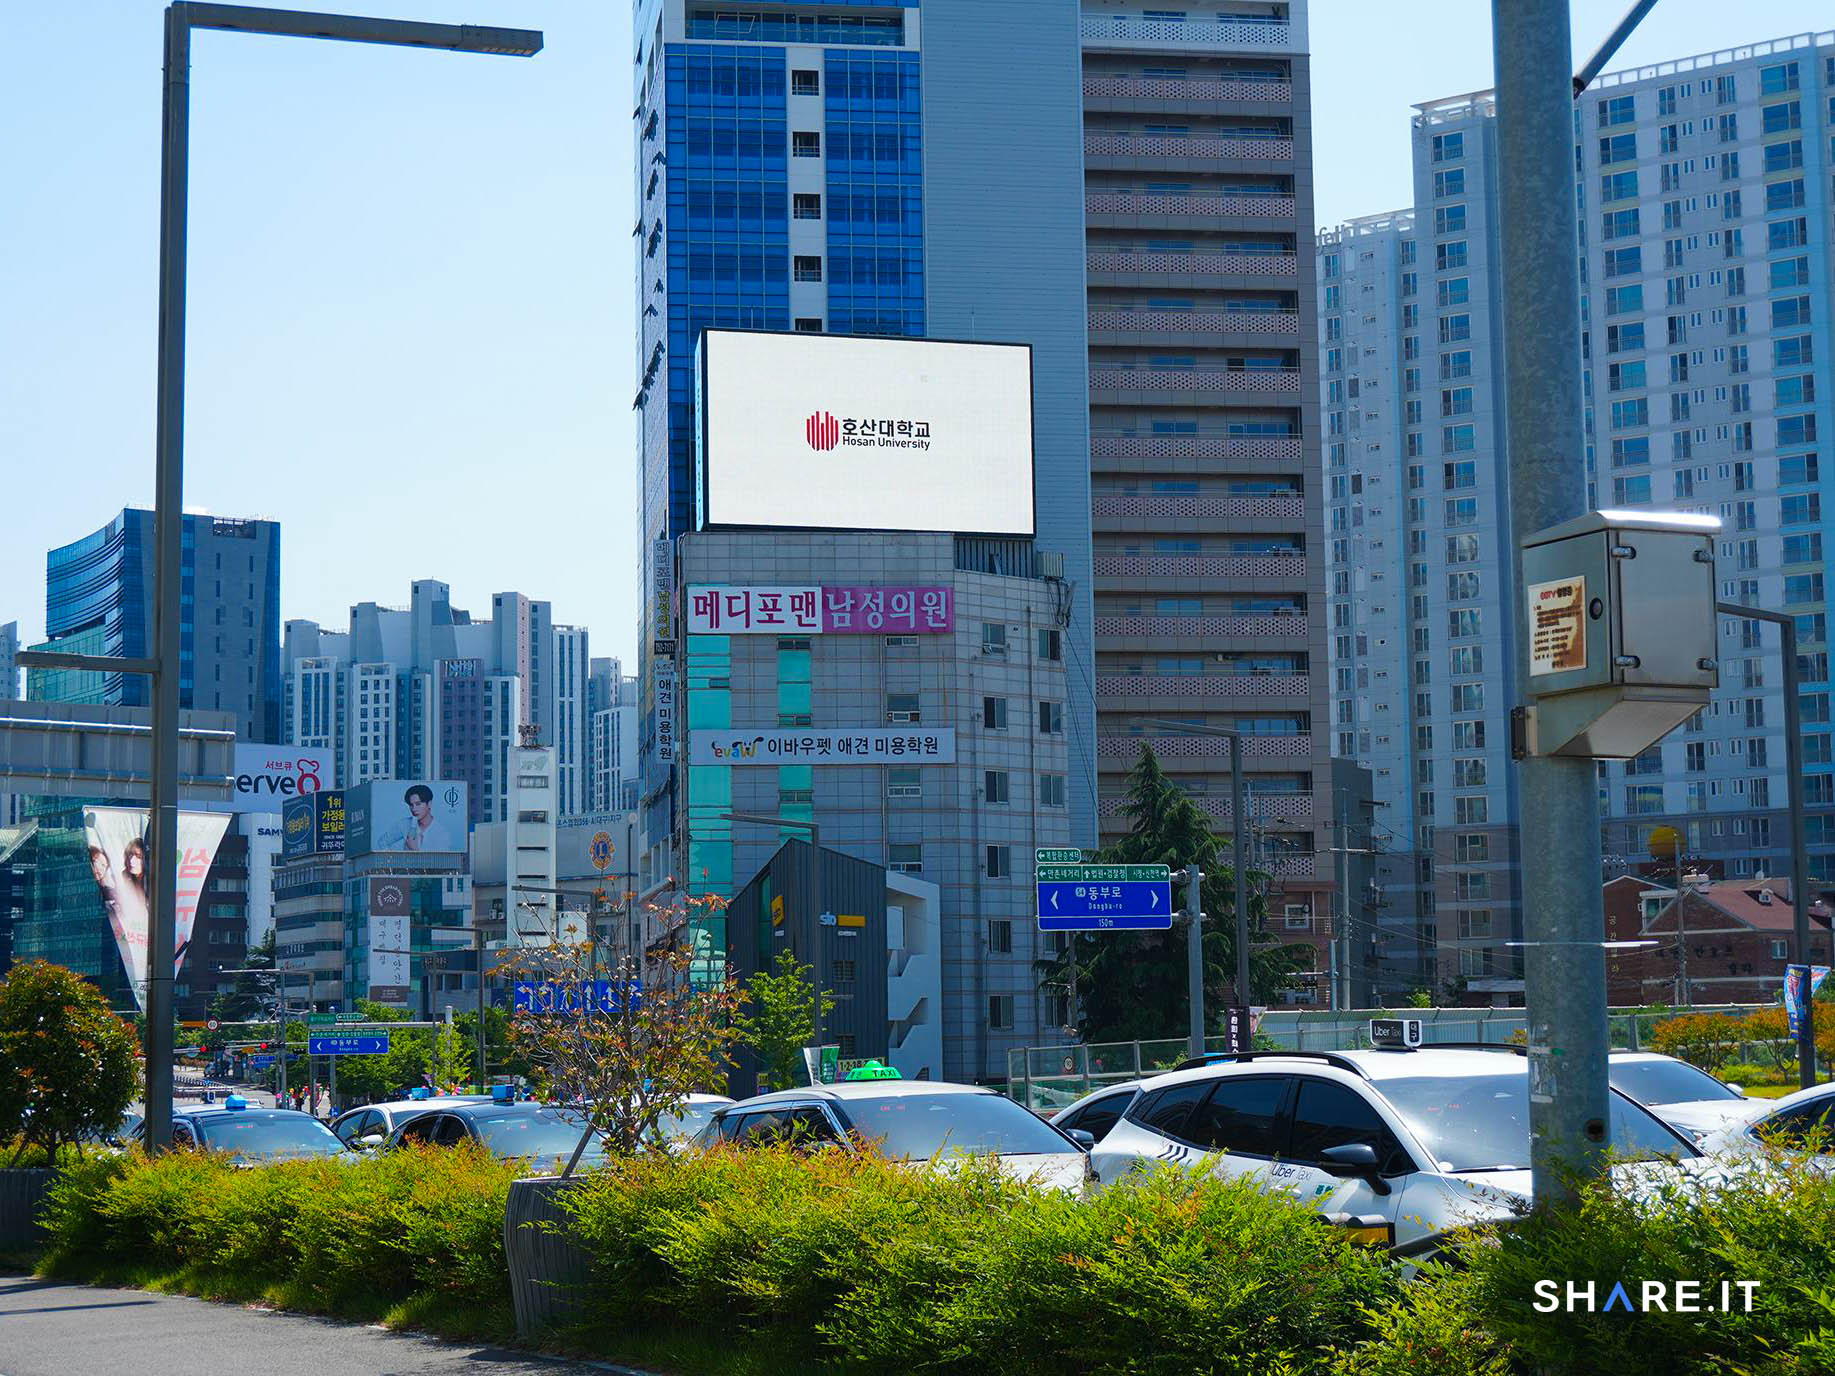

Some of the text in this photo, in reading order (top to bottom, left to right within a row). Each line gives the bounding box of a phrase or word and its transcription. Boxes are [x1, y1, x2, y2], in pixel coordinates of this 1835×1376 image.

[842, 418, 931, 437] 호산대학교
[842, 436, 931, 451] Hosan University
[693, 591, 947, 630] 메디포맨 남성의원
[659, 679, 671, 704] 애견
[659, 708, 672, 760] 미용학원
[767, 736, 939, 756] 이바우펫 애견 미용학원
[265, 760, 294, 772] 서브큐
[1047, 868, 1080, 879] 만촌네거리
[1088, 886, 1122, 900] 동부로
[1374, 1025, 1390, 1036] Uber
[872, 1069, 898, 1077] TAXI
[1271, 1162, 1296, 1178] Uber
